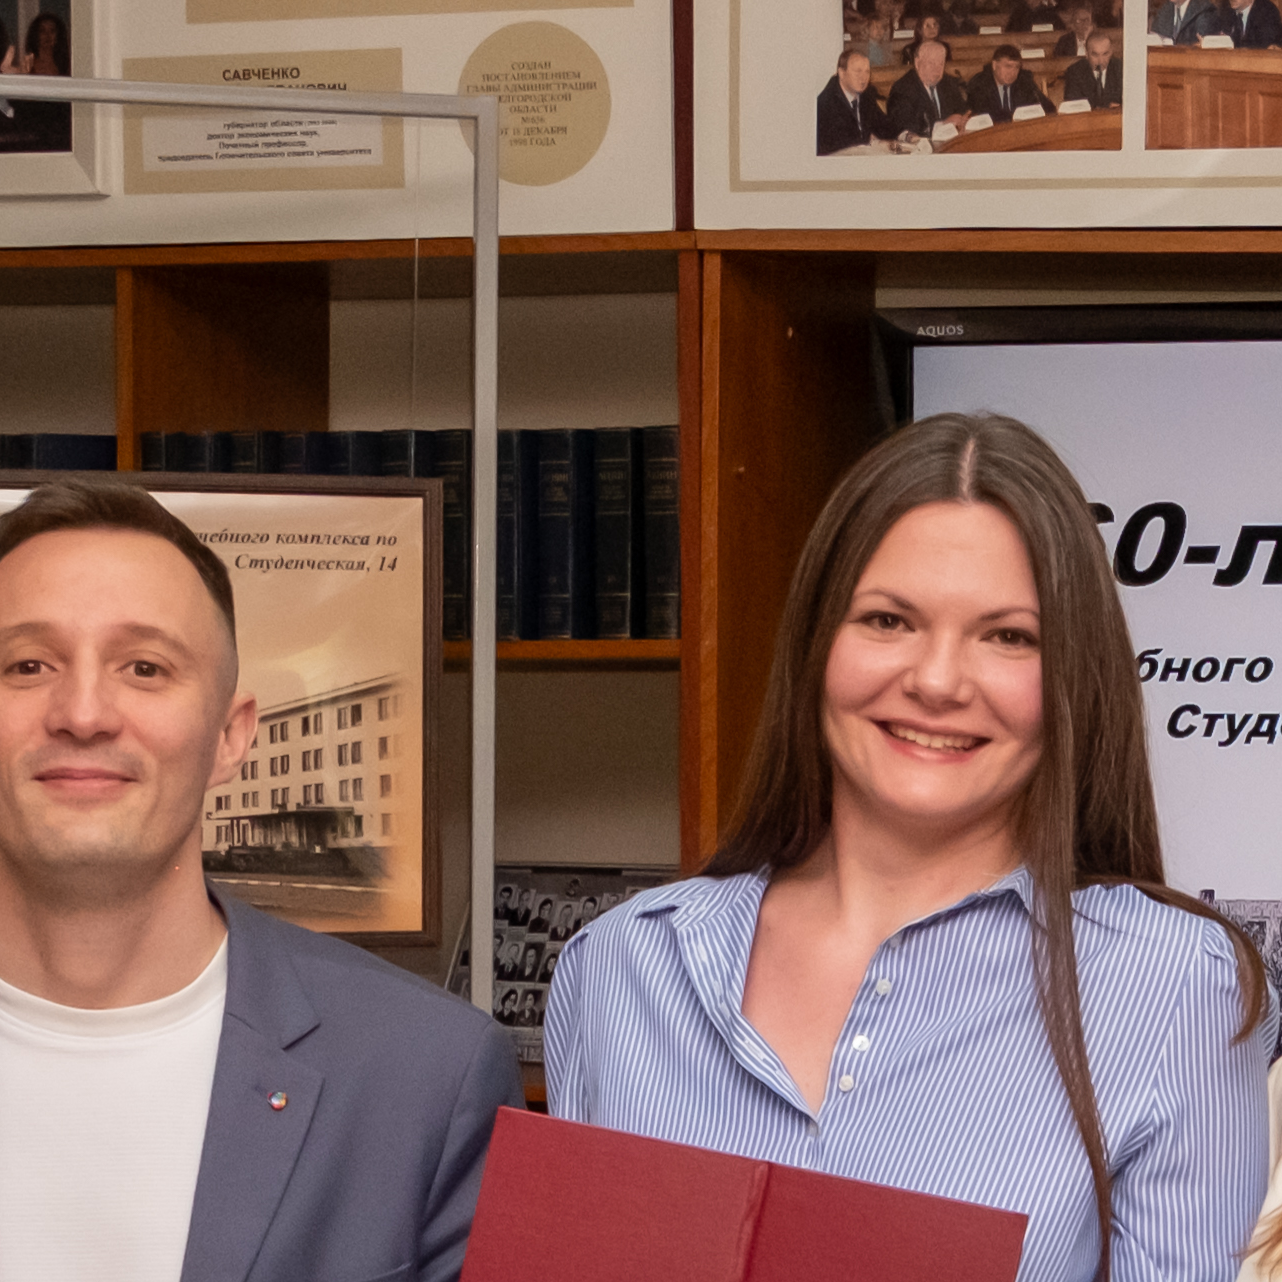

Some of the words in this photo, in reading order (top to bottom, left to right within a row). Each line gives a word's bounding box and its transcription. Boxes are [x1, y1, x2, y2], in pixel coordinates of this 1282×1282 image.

[511, 61, 551, 71] СОЗДАН
[222, 67, 301, 81] САВЧЕНКО
[482, 71, 581, 82] ПОСТАНОВЛЕНИЕМ
[498, 93, 572, 103] ЕЛГОРОДСКОЙ
[509, 104, 557, 113] ОБЛАСТИ
[916, 324, 965, 338] AQUOS
[194, 528, 270, 544] чебного
[275, 532, 370, 546] комплекса
[376, 534, 398, 547] по
[234, 554, 370, 573] Студенческая,
[377, 556, 399, 571] 14
[1136, 648, 1274, 682] бного
